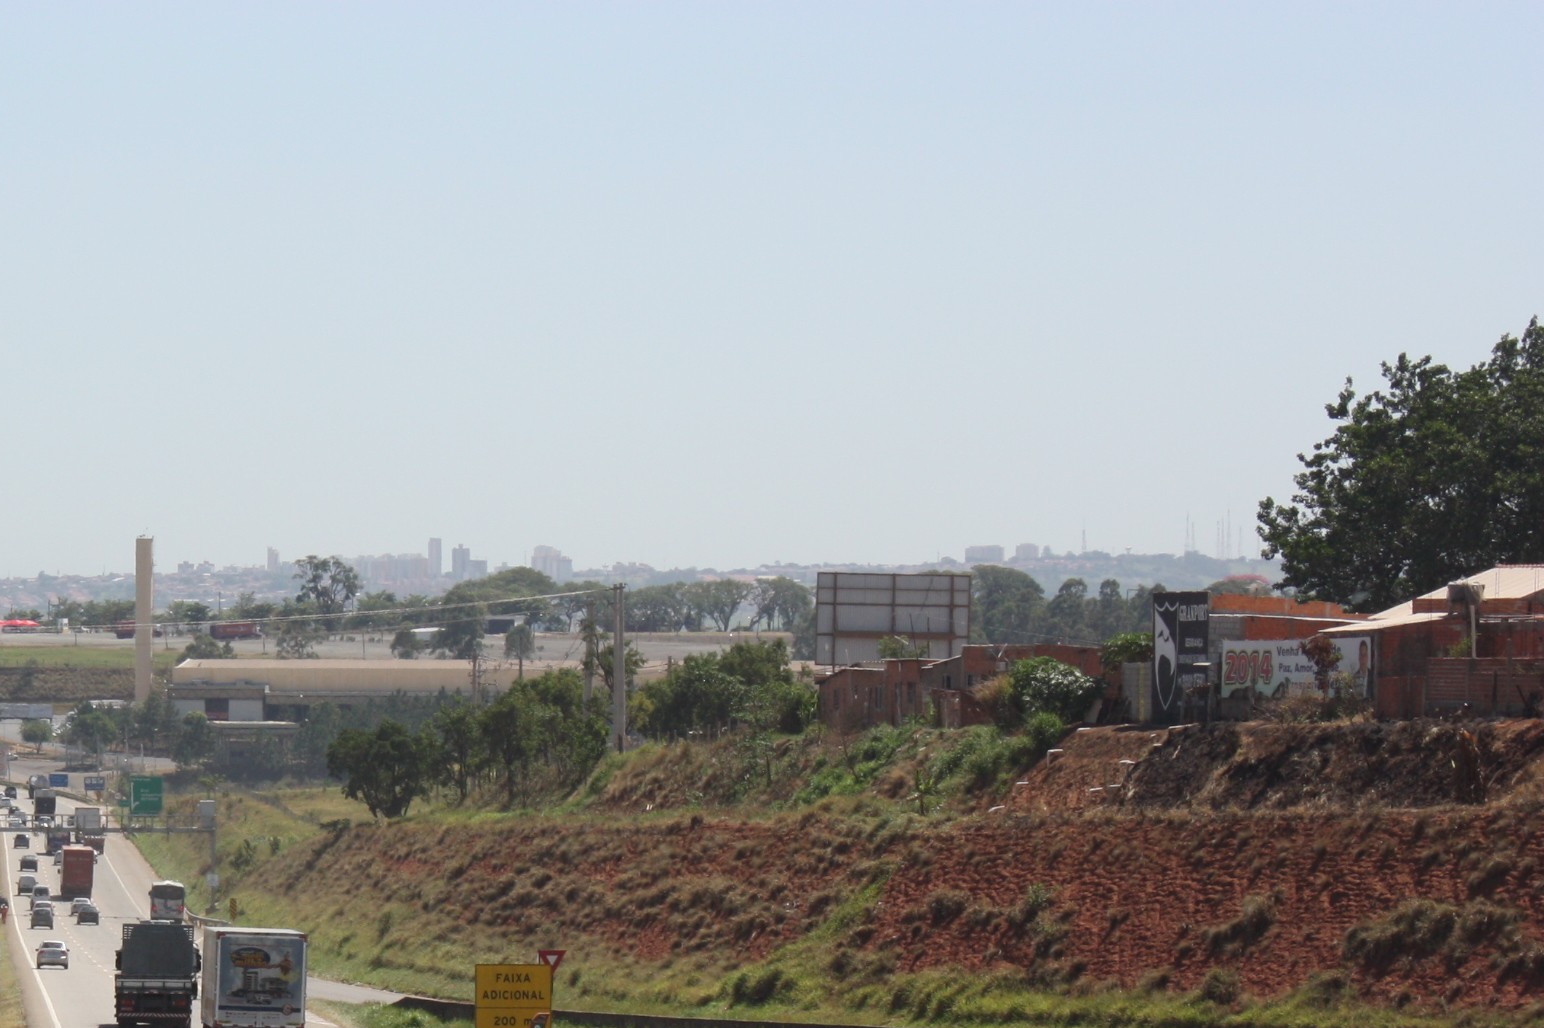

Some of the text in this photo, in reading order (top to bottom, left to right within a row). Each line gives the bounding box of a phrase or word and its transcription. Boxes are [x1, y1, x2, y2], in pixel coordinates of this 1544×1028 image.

[1276, 646, 1299, 656] Venha
[1224, 651, 1274, 685] 2014
[1278, 663, 1292, 674] Paz,
[1294, 662, 1315, 675] Amor,
[495, 973, 531, 983] FAIXA
[482, 990, 545, 1000] ADICIONAL
[494, 1016, 516, 1026] 200
